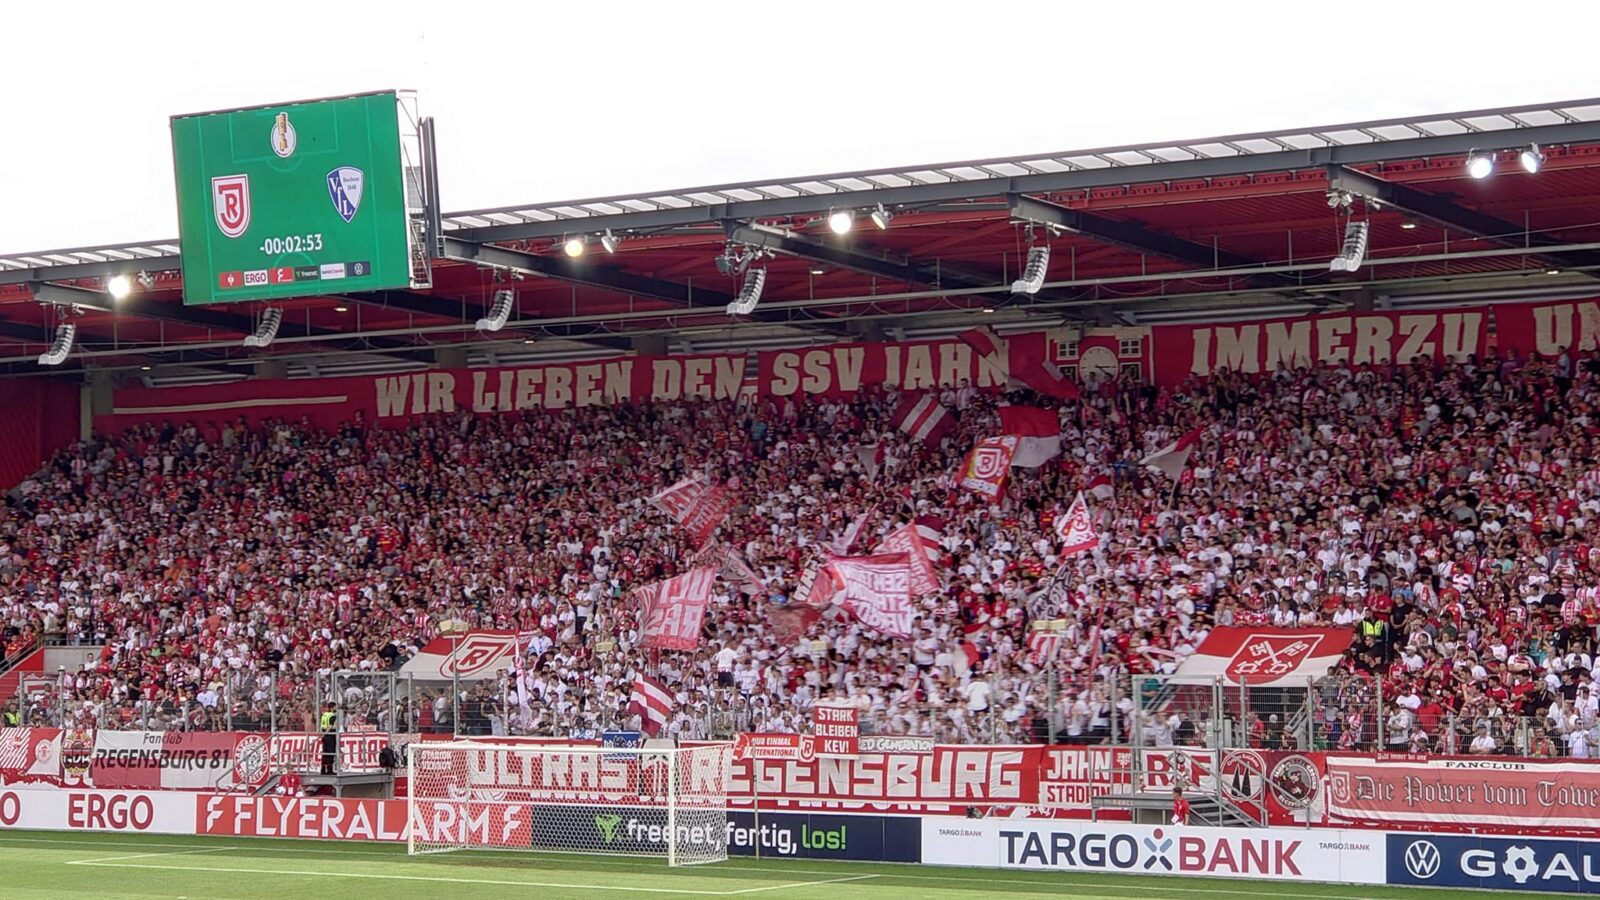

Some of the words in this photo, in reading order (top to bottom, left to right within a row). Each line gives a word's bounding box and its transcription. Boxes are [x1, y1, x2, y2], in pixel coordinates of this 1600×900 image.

[259, 233, 323, 255] -00:02:53
[245, 273, 266, 284] ERGO
[374, 372, 455, 417] WIR
[472, 360, 634, 413] LIEBEN
[651, 357, 745, 401] DEN
[771, 346, 866, 397] SSV
[884, 338, 1010, 390] JAHN
[1191, 312, 1483, 377] IMMERZU
[818, 708, 854, 722] STARK
[143, 732, 182, 744] Fanclub
[766, 737, 792, 746] EINMAL
[815, 724, 858, 738] BLEIBEN
[824, 739, 849, 754] KEV!
[94, 748, 208, 771] REGENSBURG
[209, 749, 230, 769] 81
[467, 743, 628, 790] ULTRAS
[691, 750, 1024, 798] REGENSBURG
[1047, 751, 1111, 781] JAHN
[1445, 761, 1526, 771] FANCLUB
[1355, 775, 1394, 801] Die
[1404, 775, 1475, 807] Power
[1482, 780, 1528, 806] vom
[68, 793, 154, 830] ERGO
[234, 797, 490, 844] FLYERALARM
[726, 821, 797, 854] fertig,
[802, 824, 847, 849] los!
